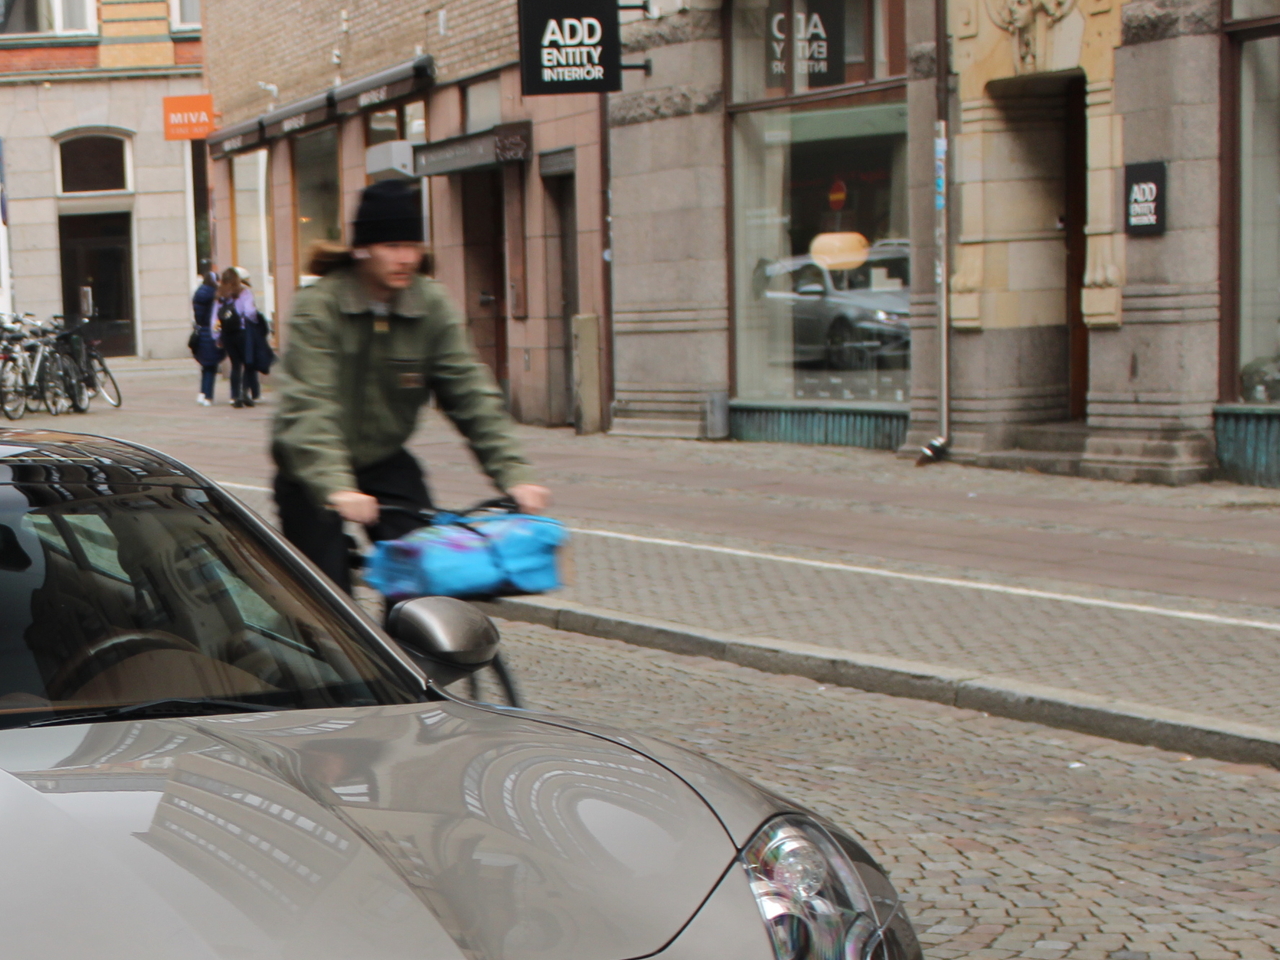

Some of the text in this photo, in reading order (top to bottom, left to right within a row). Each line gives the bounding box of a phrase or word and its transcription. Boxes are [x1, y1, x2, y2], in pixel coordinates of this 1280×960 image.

[542, 17, 602, 46] ADD
[541, 46, 602, 66] ENTITY
[542, 63, 604, 82] INTERIÖR
[169, 111, 209, 125] MIVA
[1130, 182, 1157, 203] ADD
